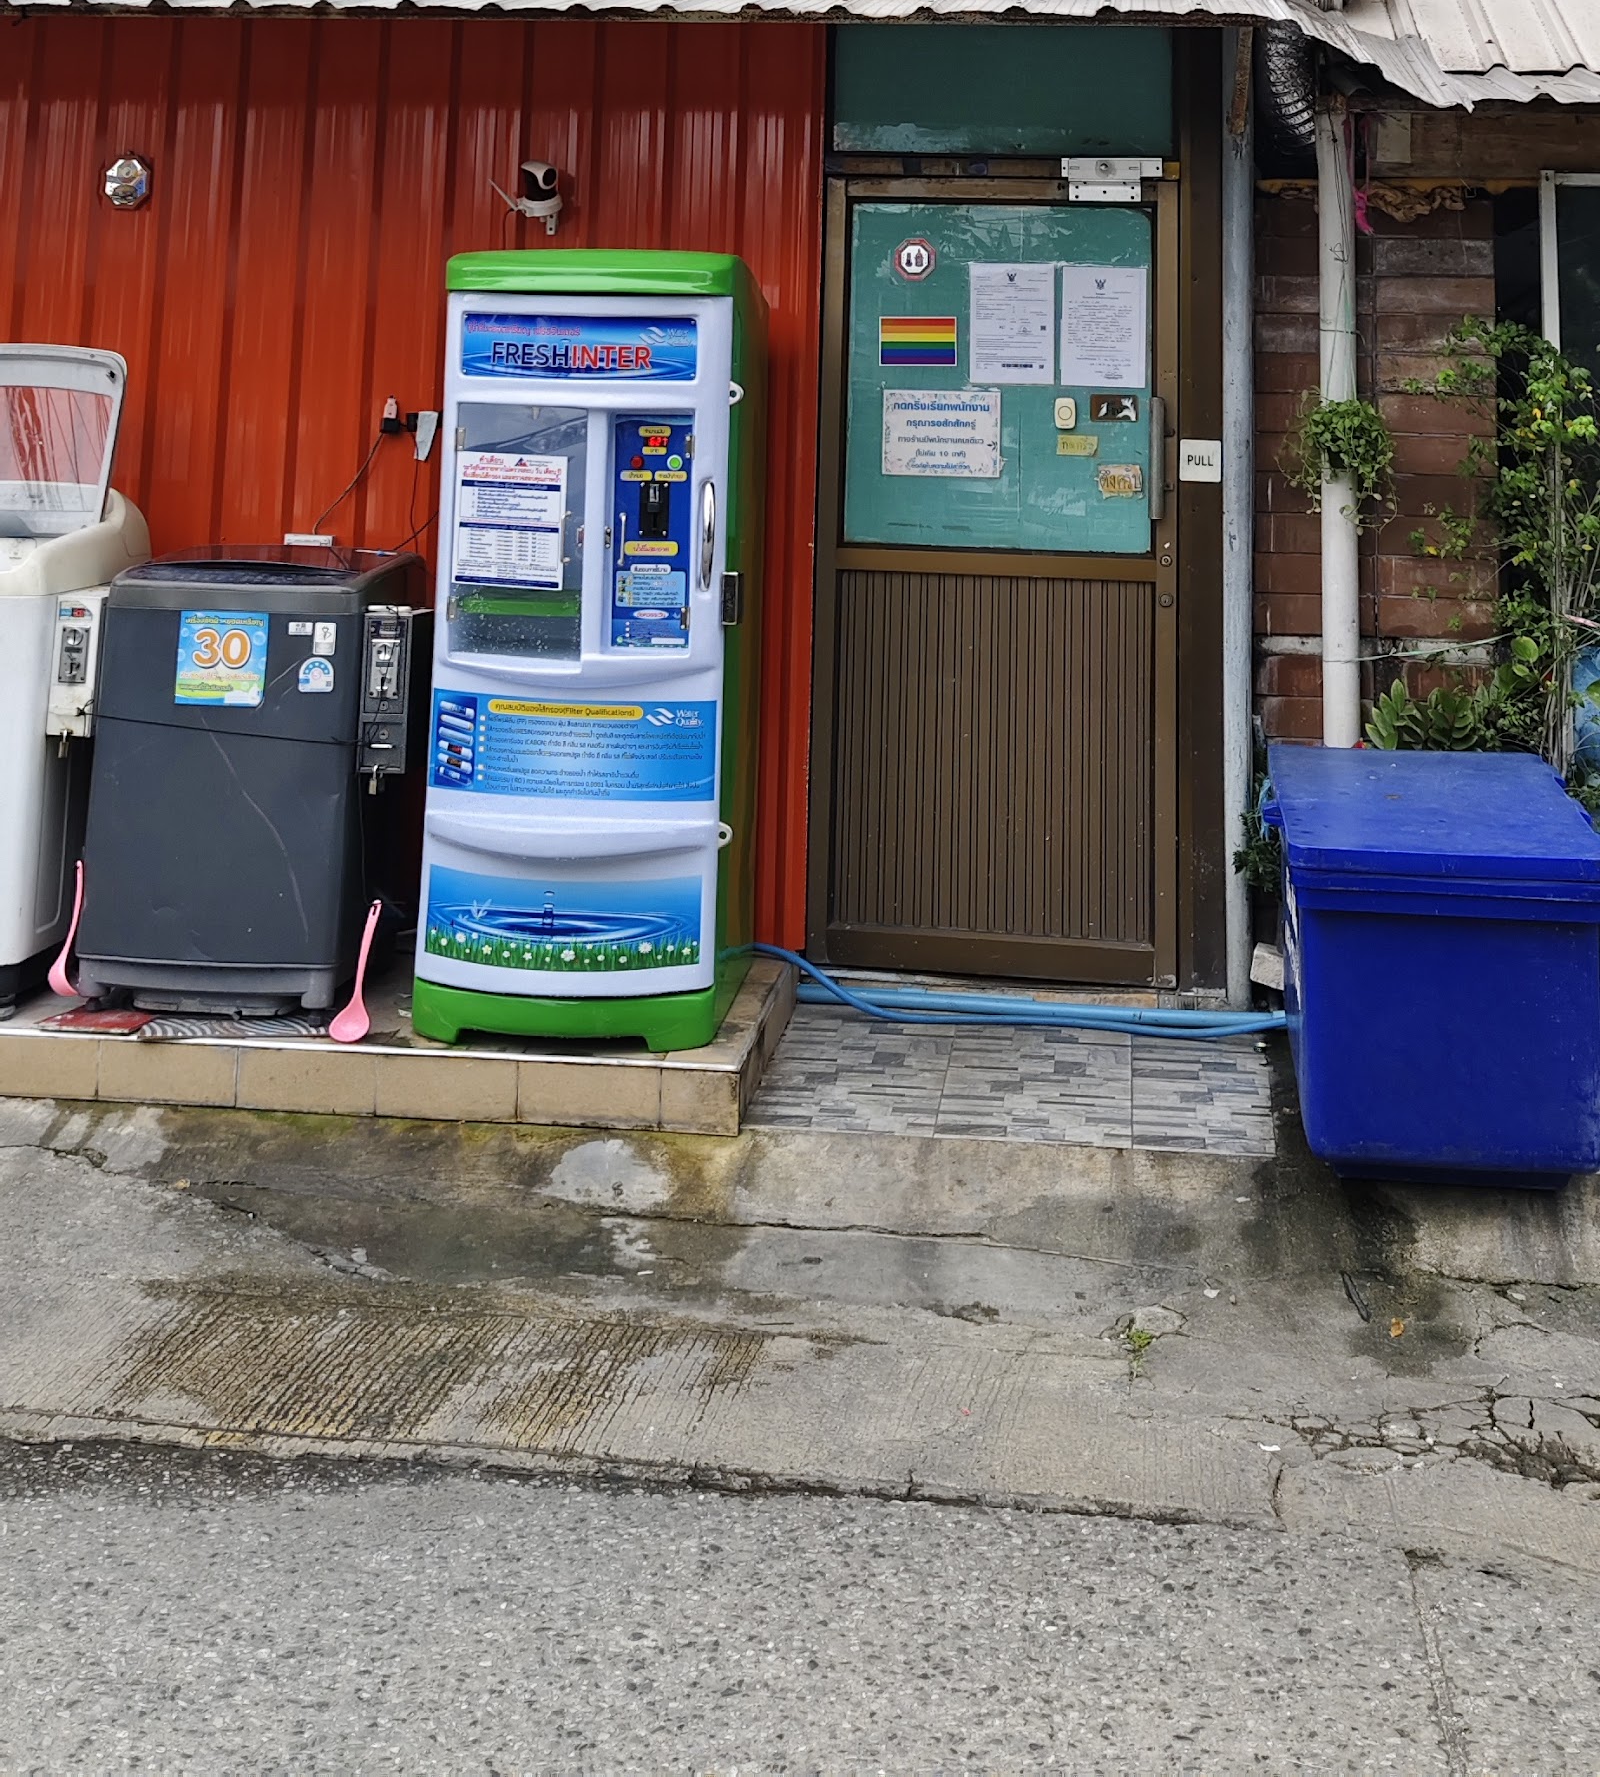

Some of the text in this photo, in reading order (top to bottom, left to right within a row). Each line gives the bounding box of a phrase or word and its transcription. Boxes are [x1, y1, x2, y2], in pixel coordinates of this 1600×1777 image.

[491, 341, 652, 369] FRESHINTER
[893, 398, 990, 412] กดกริ่งเรียกพนักงาน
[1187, 454, 1214, 466] PULL
[192, 628, 251, 668] 30
